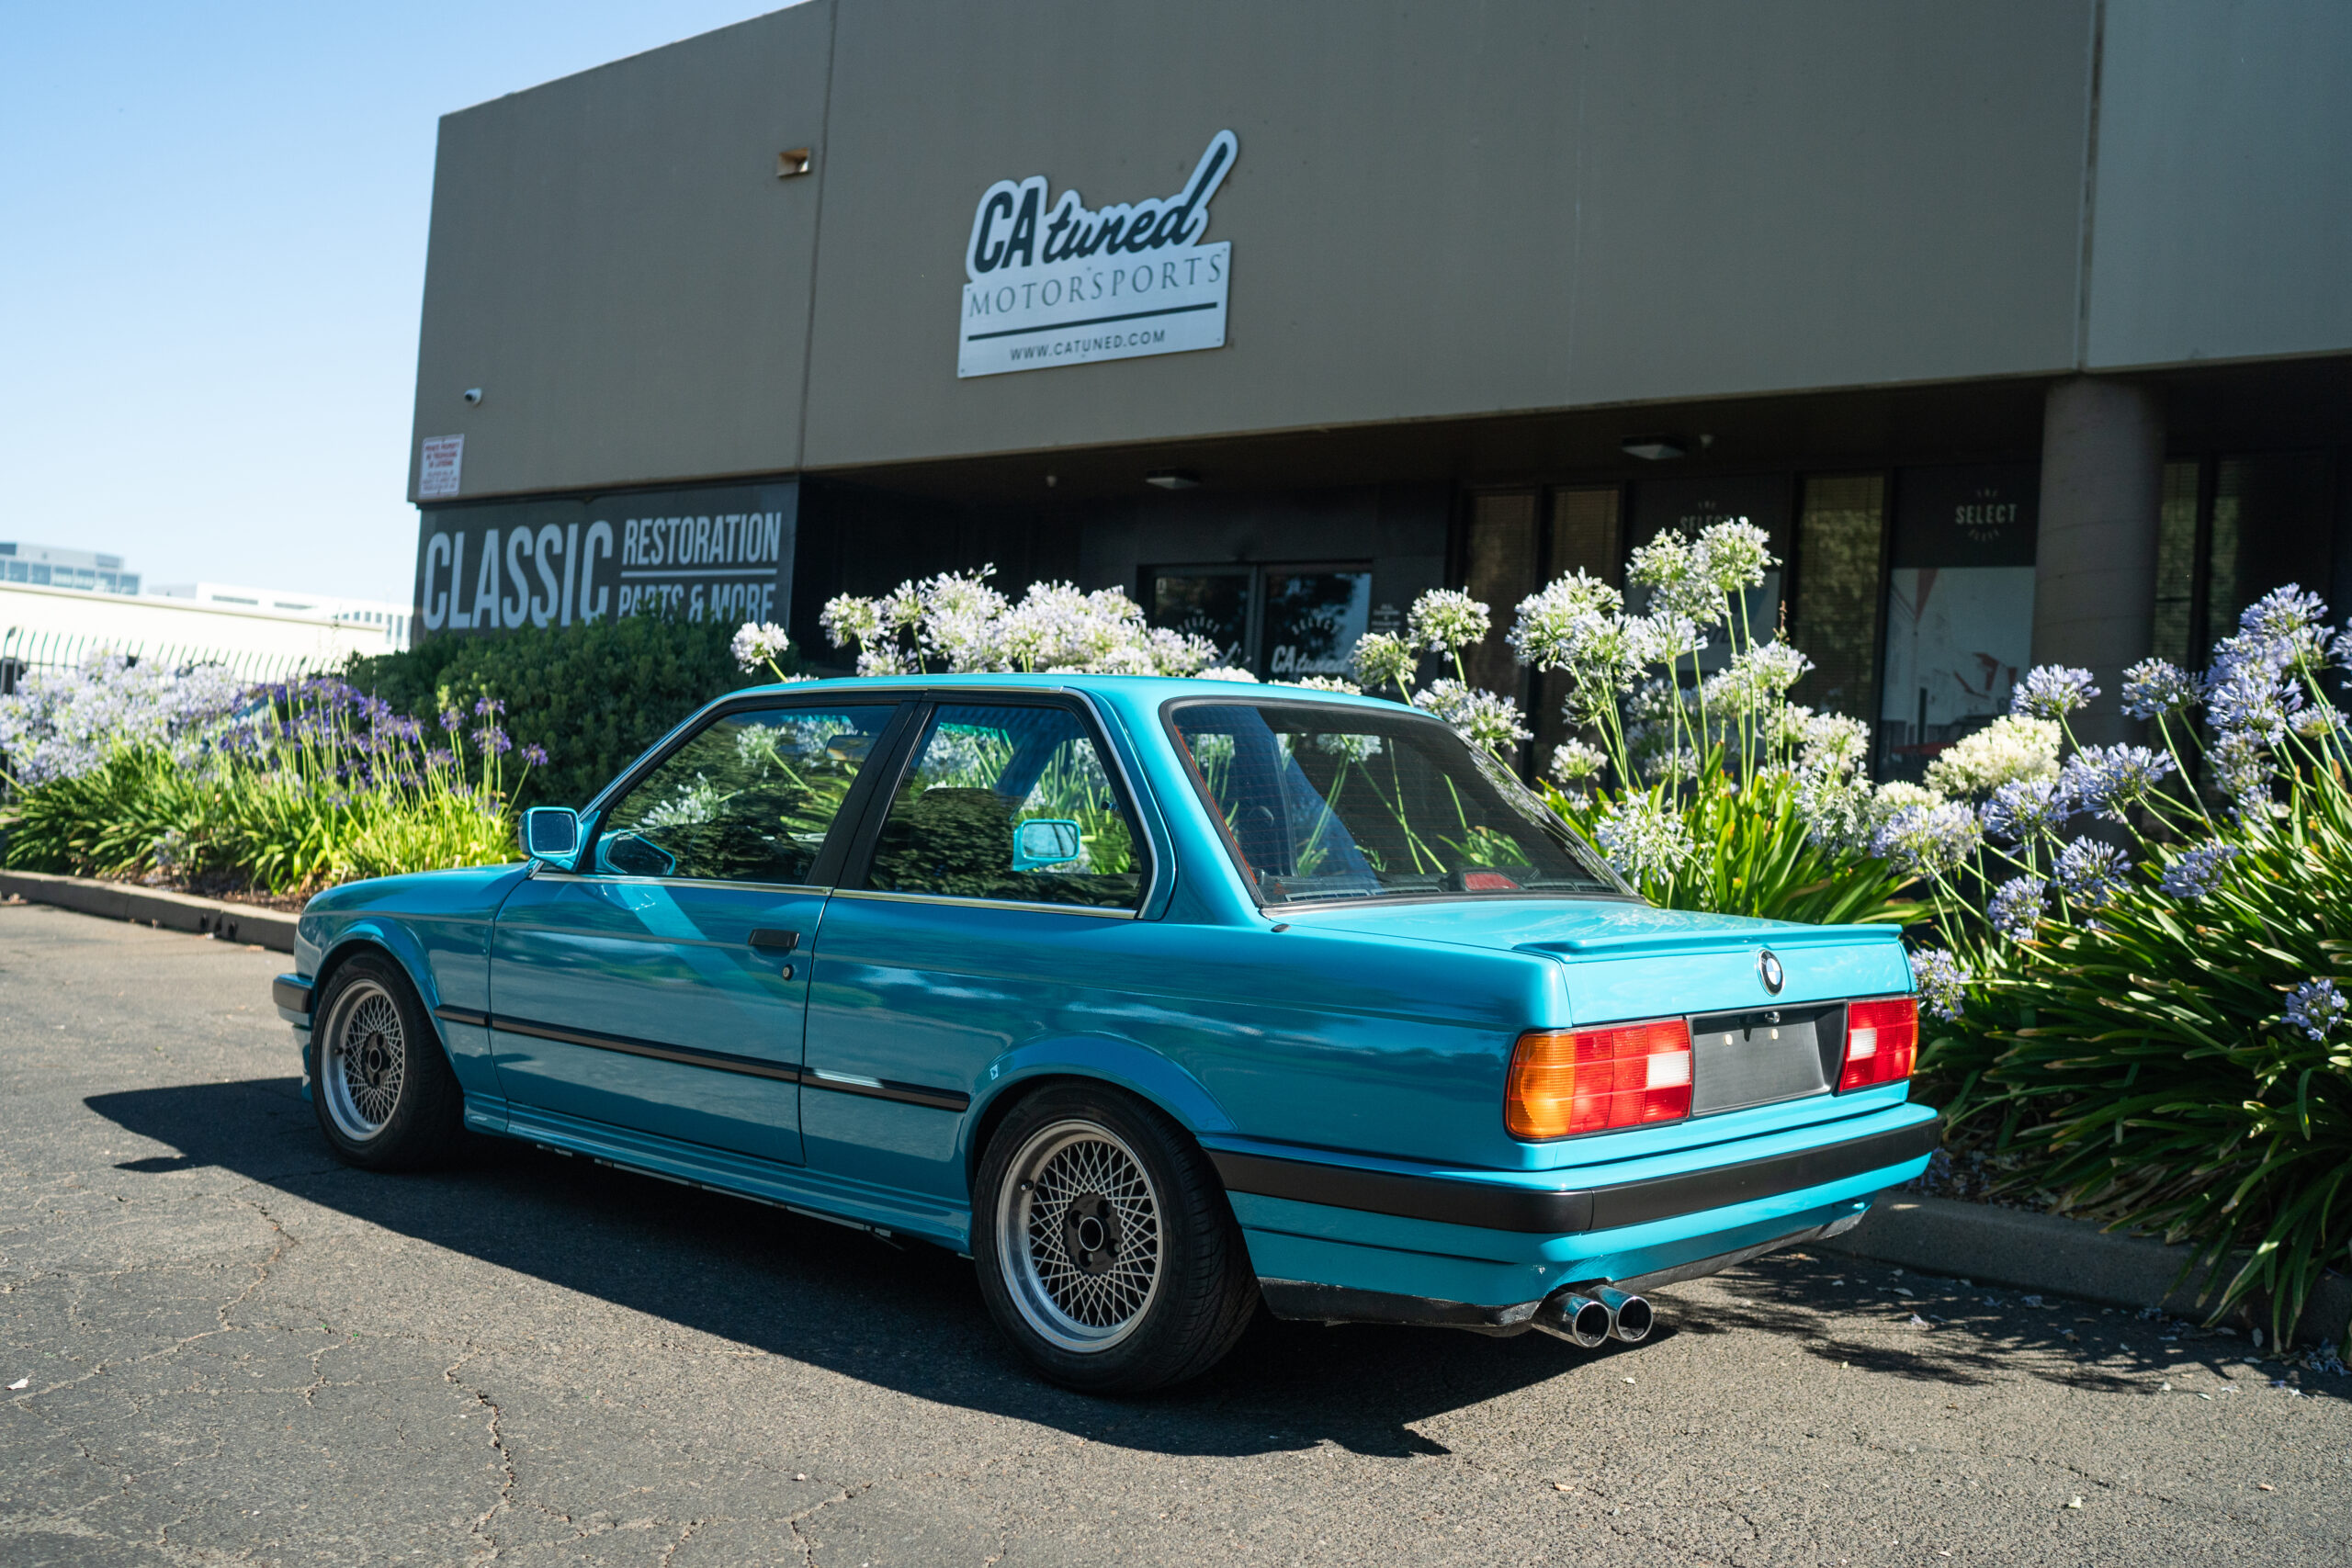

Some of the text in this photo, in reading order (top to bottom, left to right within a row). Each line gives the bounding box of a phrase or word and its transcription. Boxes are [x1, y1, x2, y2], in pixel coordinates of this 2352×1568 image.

[969, 254, 1222, 317] MOTORSPORTS
[1010, 330, 1166, 361] WWW.CATUNED.COM
[1955, 503, 2018, 525] SELECT
[623, 513, 781, 565] RESTORATION
[425, 521, 613, 629] CLASSIC
[688, 584, 704, 624] &
[711, 583, 776, 626] MORE
